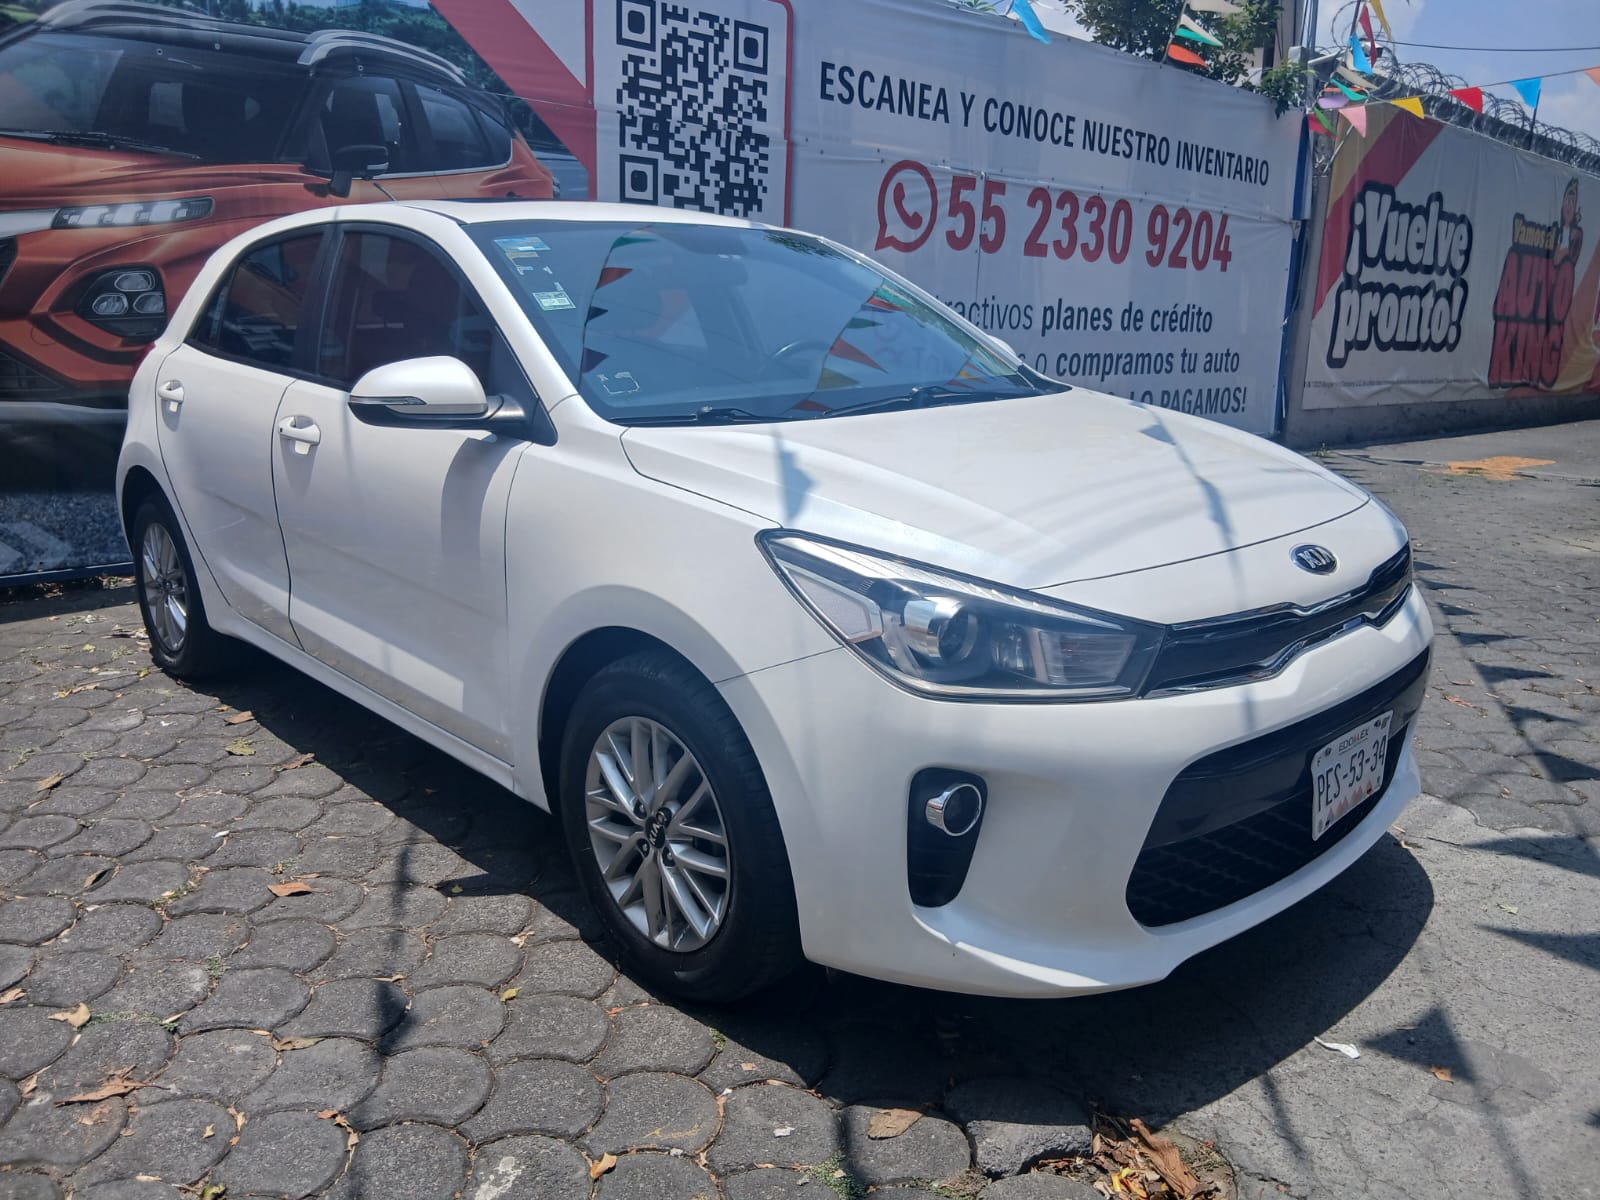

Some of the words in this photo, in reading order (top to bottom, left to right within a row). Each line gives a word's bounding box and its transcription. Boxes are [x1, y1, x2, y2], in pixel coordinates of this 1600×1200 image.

[819, 61, 950, 124] ESCANEA
[960, 92, 976, 127] Y
[983, 97, 1075, 147] CONOCE
[1082, 118, 1170, 166] NUESTRO
[1175, 140, 1269, 186] INVENTARIO
[945, 175, 1007, 254] 55
[1023, 187, 1133, 265] 2330
[1145, 204, 1232, 272] 9204
[1345, 187, 1470, 277] ¡Vuelve
[1041, 299, 1112, 336] planes
[1120, 301, 1143, 331] de
[1150, 302, 1213, 333] crédito
[1330, 279, 1467, 362] pronto!
[1495, 251, 1575, 321] AUTO
[1035, 354, 1047, 375] o
[1056, 350, 1174, 381] compramos
[1180, 349, 1197, 374] tu
[1203, 348, 1240, 374] auto
[1489, 321, 1563, 387] KING
[1160, 386, 1247, 415] PAGAMOS!
